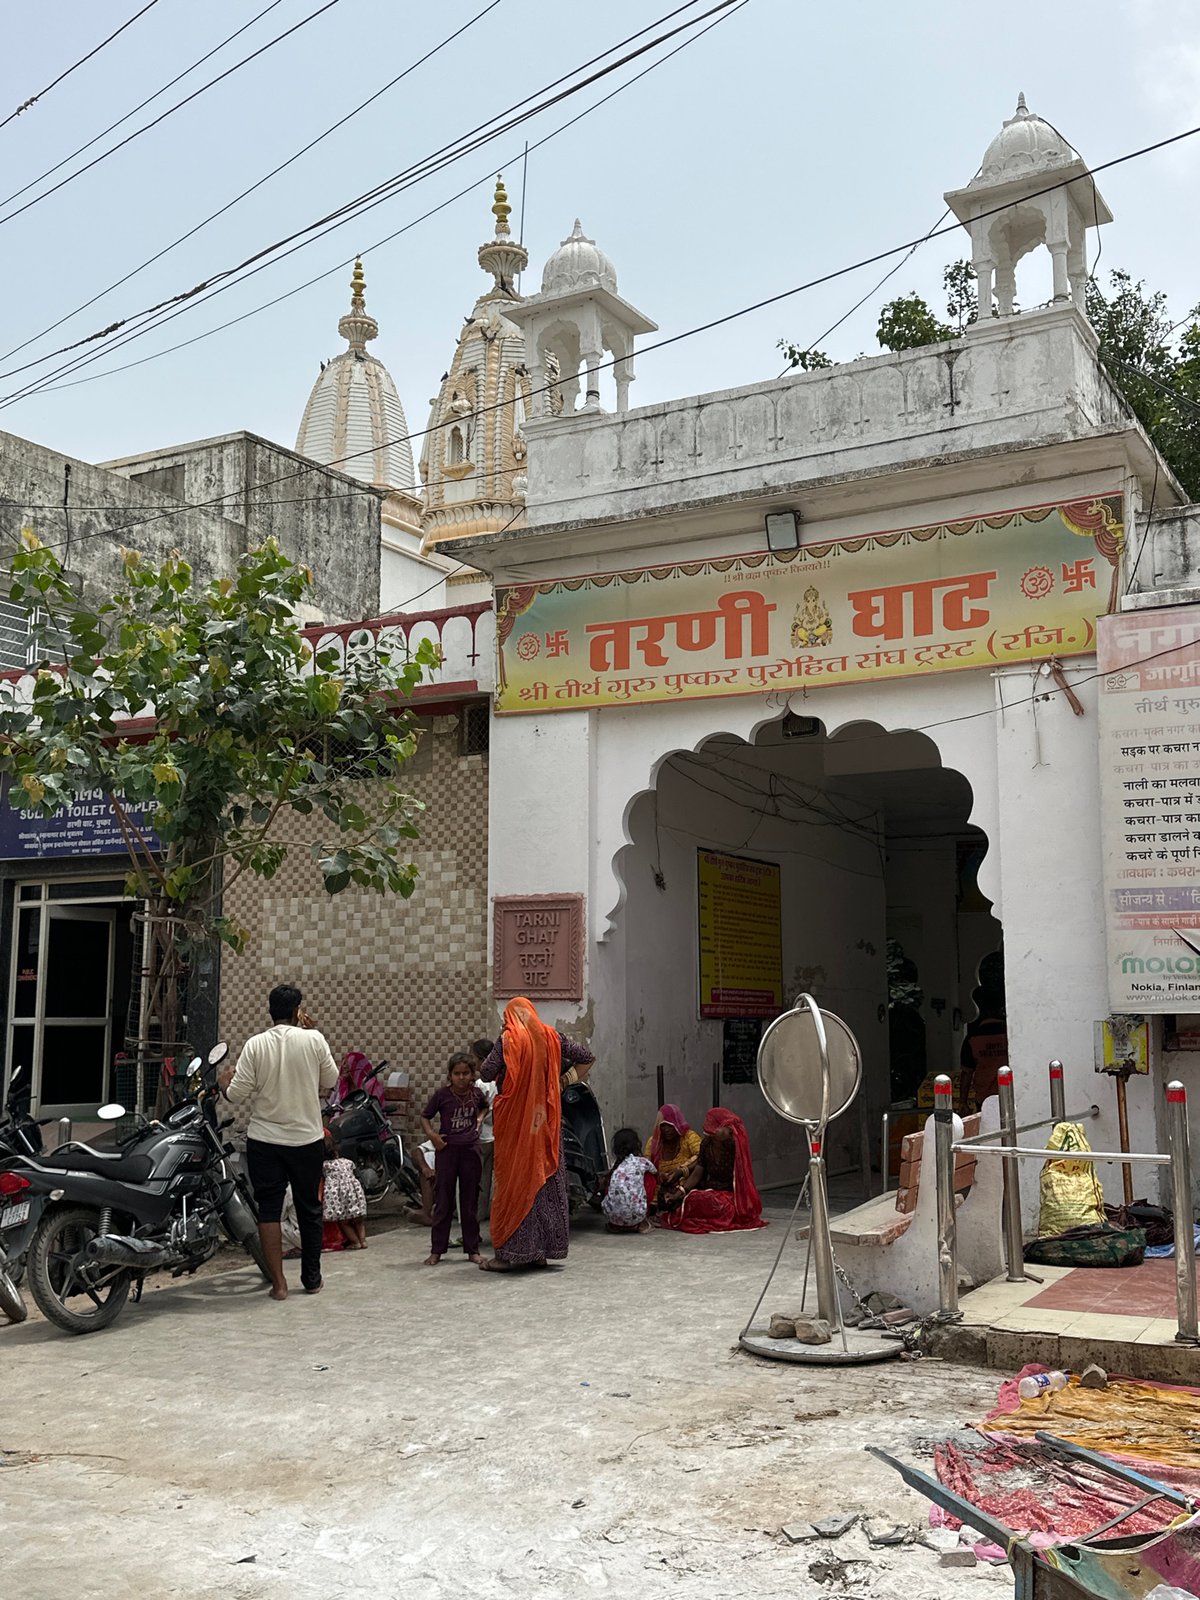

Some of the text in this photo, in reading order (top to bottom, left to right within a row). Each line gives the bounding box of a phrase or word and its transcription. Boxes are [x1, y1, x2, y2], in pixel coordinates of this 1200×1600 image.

[585, 571, 997, 672] तरणी घाट
[518, 682, 550, 701] श्री
[554, 676, 601, 699] तीर्थ
[607, 676, 658, 700] गुरु
[663, 668, 741, 695] पुष्कर
[746, 655, 849, 687] पुरोहित
[855, 644, 907, 670] संघ
[914, 640, 976, 667] ट्रस्ट
[1134, 696, 1168, 714] तीर्थ
[1148, 744, 1160, 754] पर
[1162, 743, 1190, 754] कचरा
[1172, 760, 1189, 770] का
[1122, 778, 1149, 790] नाली
[1151, 780, 1167, 789] का
[1184, 792, 1194, 804] में
[20, 807, 64, 820] SULH
[67, 804, 106, 818] TOILET
[1124, 834, 1156, 844] कचरा
[1158, 828, 1190, 842] डालने
[1125, 848, 1154, 861] कचरे
[1156, 847, 1168, 860] के
[1170, 846, 1190, 863] पूर्ण
[1118, 890, 1153, 906] सौजन्य
[1156, 890, 1165, 905] से
[514, 912, 560, 928] TARNI
[516, 930, 558, 945] GHAT
[523, 970, 551, 986] घाट
[1131, 983, 1165, 992] Nokia,
